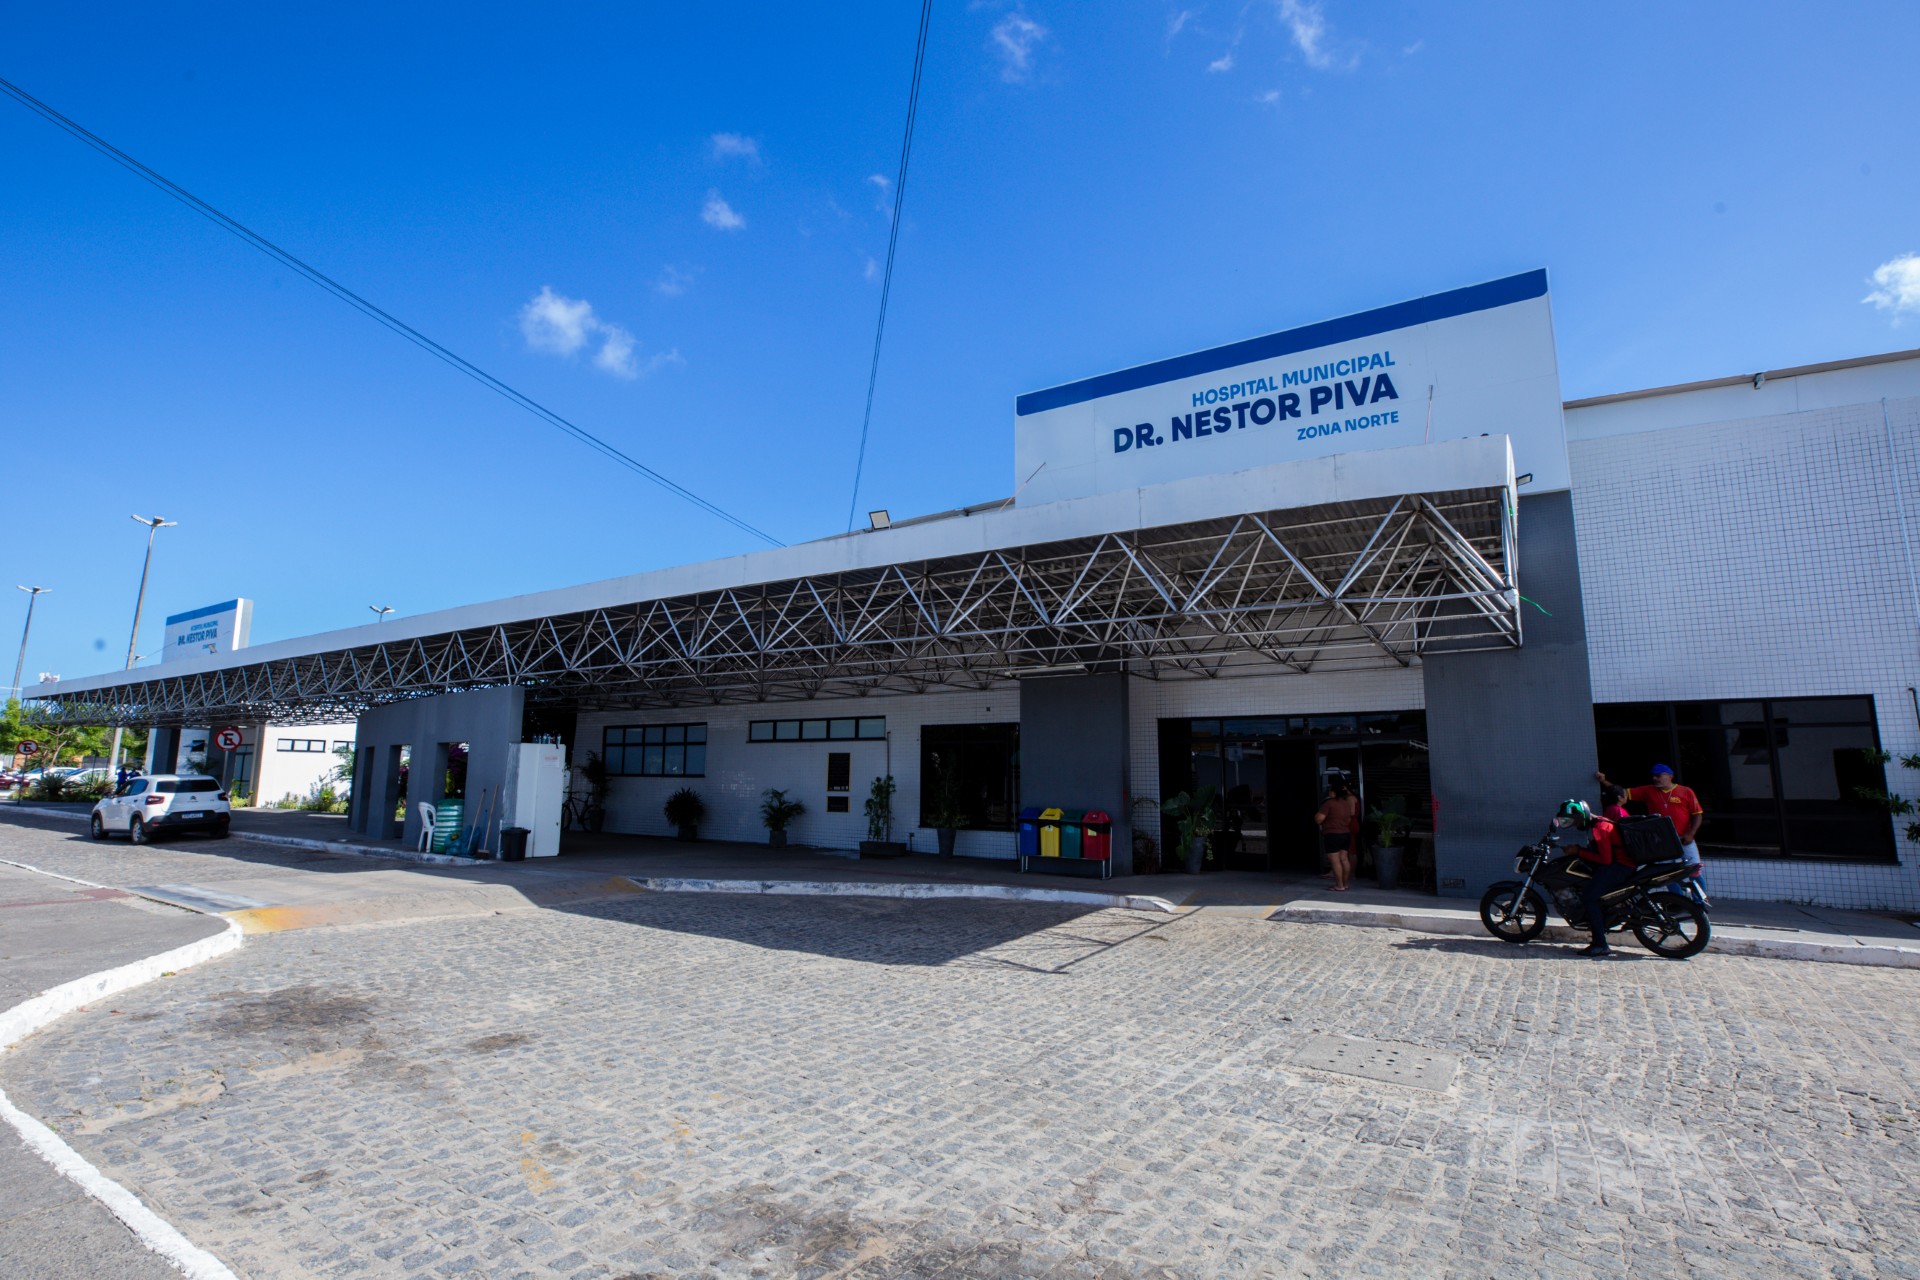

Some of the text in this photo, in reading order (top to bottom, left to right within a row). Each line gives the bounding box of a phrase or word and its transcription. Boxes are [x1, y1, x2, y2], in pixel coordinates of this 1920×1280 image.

[1192, 351, 1396, 407] HOSPITAL MUNICIPAL
[1113, 373, 1399, 453] DR. NESTOR PIVA
[1297, 411, 1399, 441] ZONA NORTE
[205, 628, 217, 640] PIVA
